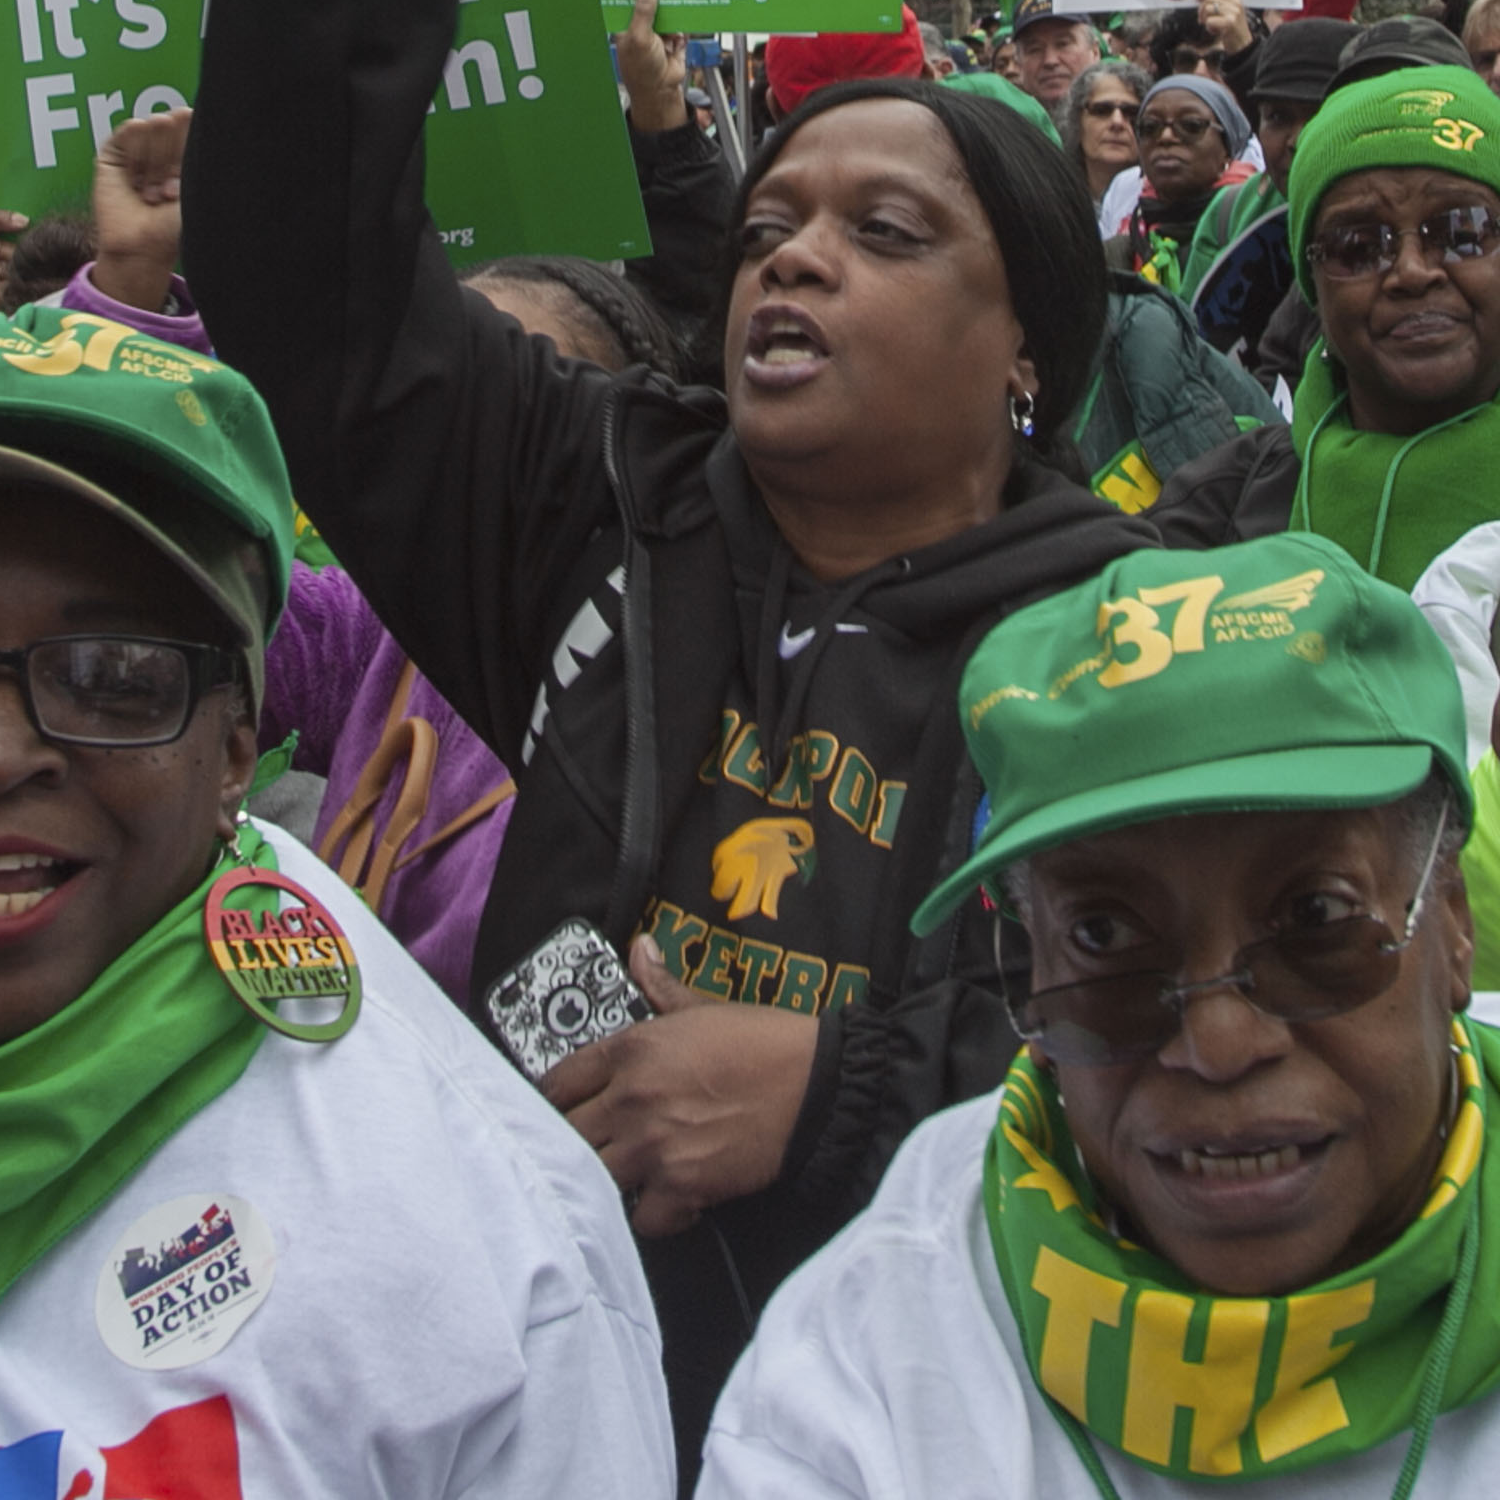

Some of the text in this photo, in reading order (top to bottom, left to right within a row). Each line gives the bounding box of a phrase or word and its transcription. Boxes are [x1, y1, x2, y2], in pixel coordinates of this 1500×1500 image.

[1432, 117, 1485, 152] 37
[118, 347, 192, 375] AFSCME
[118, 360, 194, 384] AFL-CIO
[1097, 573, 1224, 689] 37
[1210, 610, 1289, 630] AFSCME
[1214, 621, 1296, 644] AFL-CIO
[221, 907, 330, 941] BLACK
[228, 936, 339, 970] LIVES
[237, 966, 350, 1000] MATTER
[132, 1274, 196, 1330] DAY
[204, 1246, 242, 1283] OF
[142, 1267, 252, 1349] ACTION
[1030, 1243, 1377, 1476] THE
